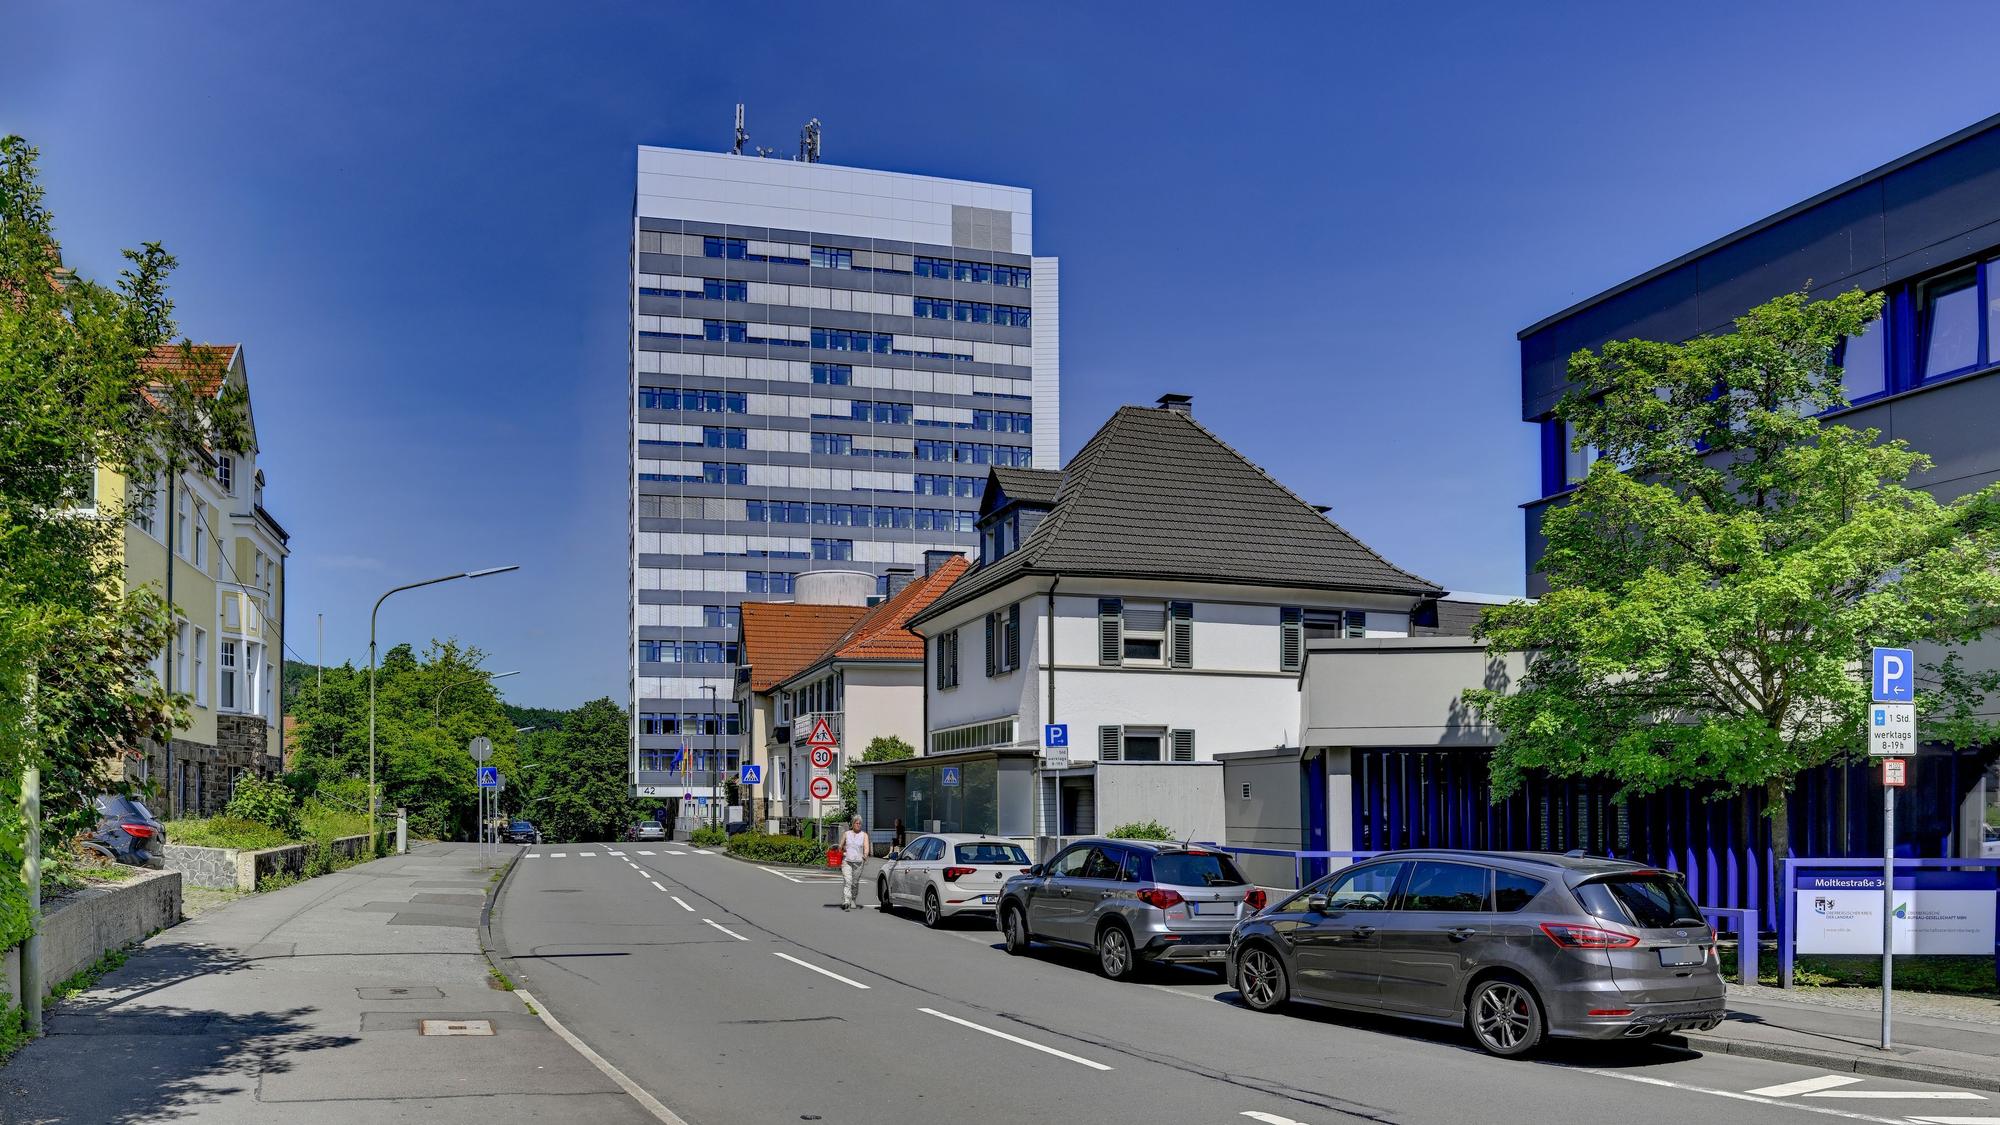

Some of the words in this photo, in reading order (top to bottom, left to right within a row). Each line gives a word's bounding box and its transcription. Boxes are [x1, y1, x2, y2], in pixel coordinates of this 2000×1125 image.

[1882, 655, 1904, 695] P
[1896, 714, 1911, 723] Std.
[1051, 727, 1062, 744] P
[1874, 731, 1912, 741] werktags
[815, 751, 828, 762] 30
[643, 786, 656, 795] 42
[1815, 878, 1875, 887] Moltkestraße
